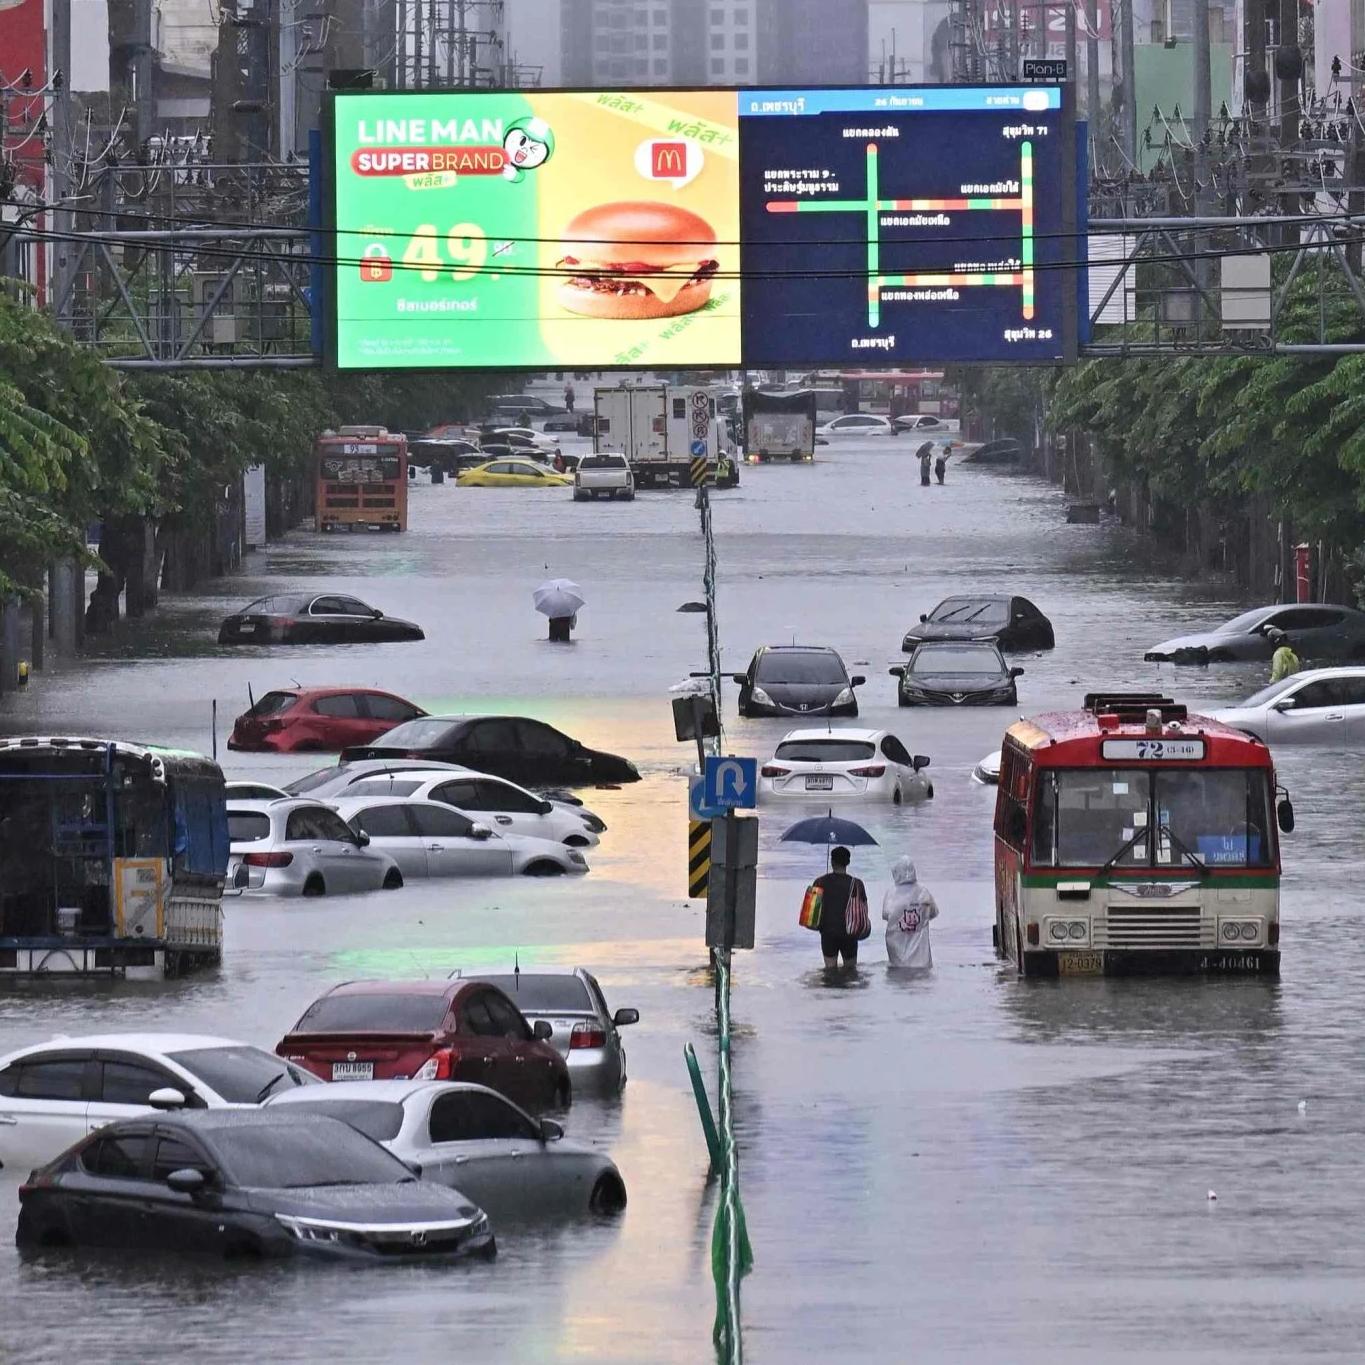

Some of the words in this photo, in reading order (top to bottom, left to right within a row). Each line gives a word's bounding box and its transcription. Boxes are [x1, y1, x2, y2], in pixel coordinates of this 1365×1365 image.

[357, 121, 427, 144] LINE
[432, 118, 502, 143] MAN
[358, 152, 429, 172] SUPER
[433, 152, 504, 171] BRAND
[1138, 741, 1164, 758] 72
